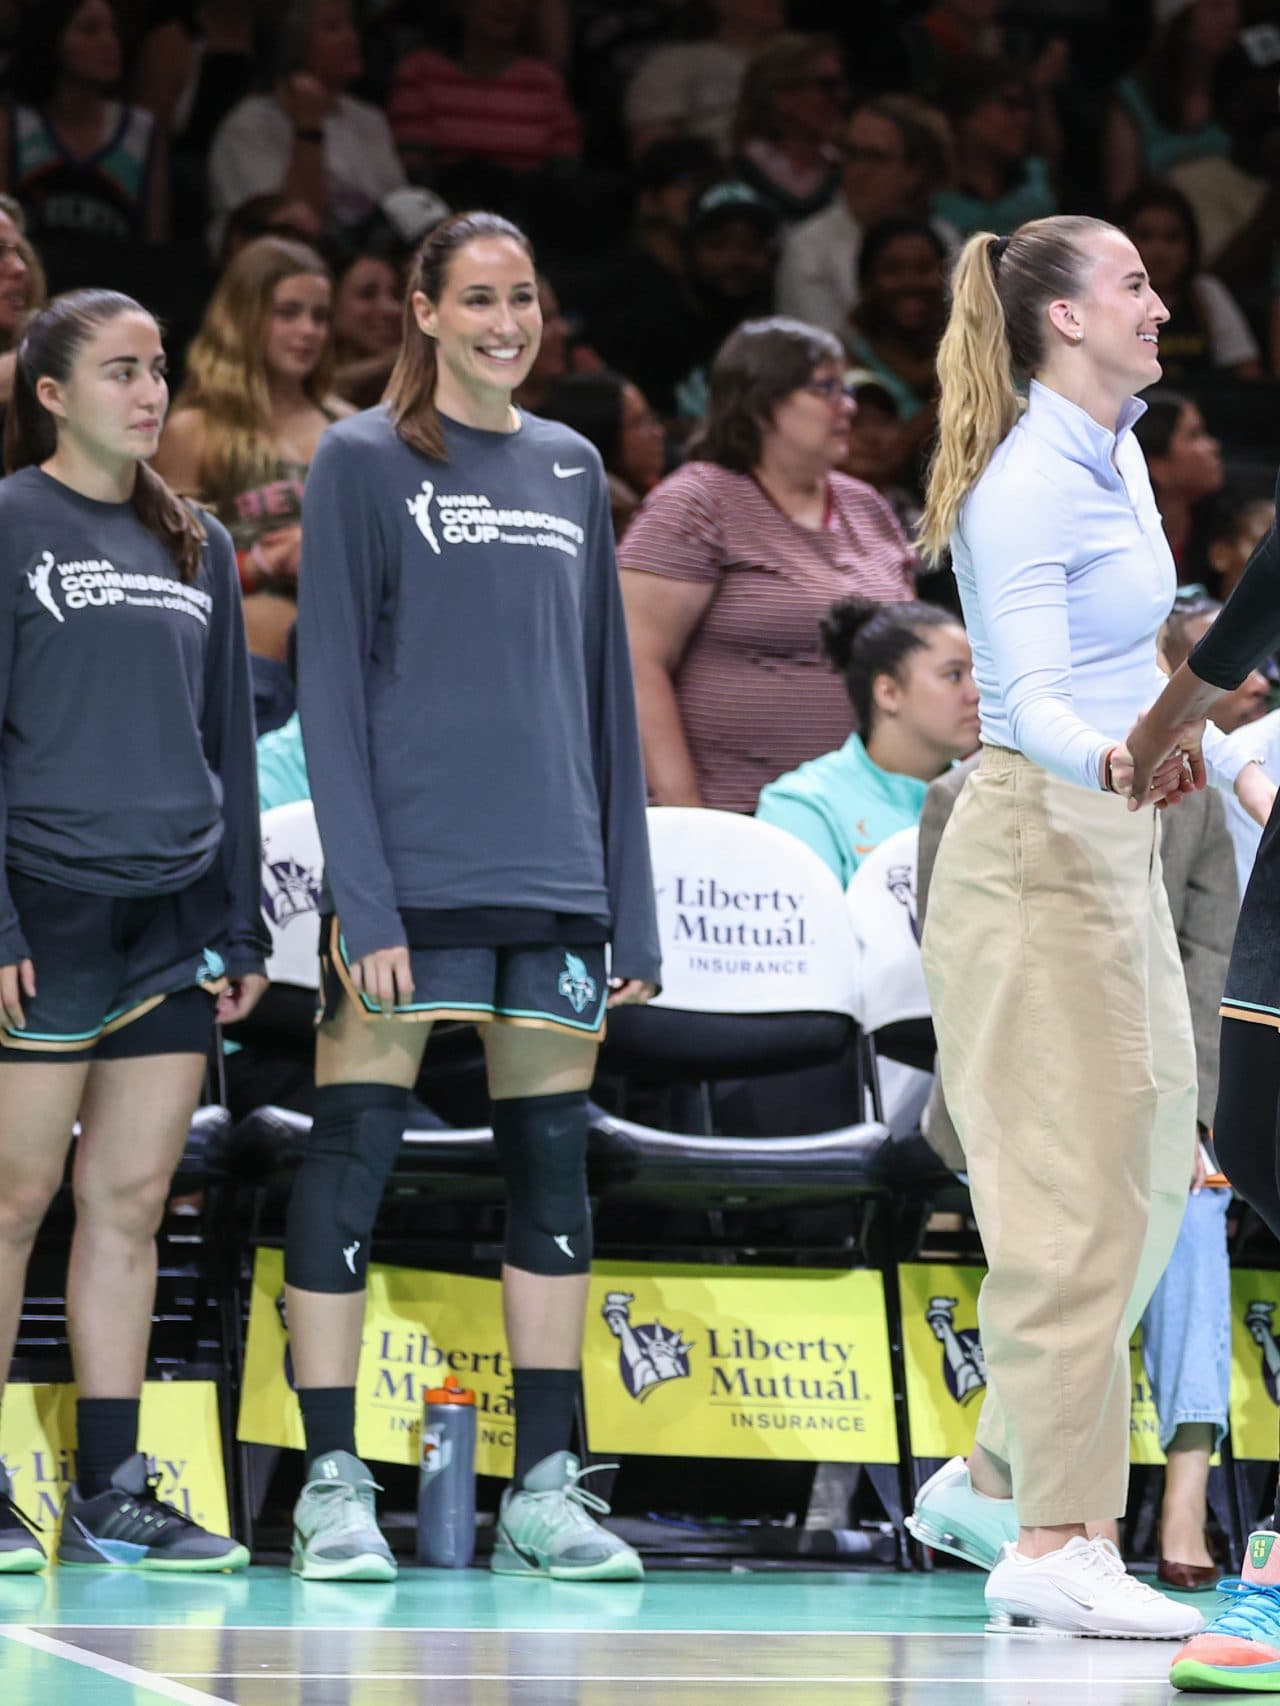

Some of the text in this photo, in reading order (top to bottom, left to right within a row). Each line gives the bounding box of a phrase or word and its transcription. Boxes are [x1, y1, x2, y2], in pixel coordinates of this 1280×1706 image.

[436, 495, 491, 508] WNBA
[443, 525, 500, 543] CUP
[57, 559, 115, 576] WNBA
[65, 587, 125, 608] CUP
[676, 877, 804, 922] Liberty
[688, 956, 809, 975] INSURANCE
[379, 1330, 513, 1378] Libert
[706, 1327, 855, 1375] Liberty
[389, 1415, 513, 1448] INSNC
[730, 1411, 866, 1433] INSURANCE
[32, 1450, 186, 1493] Lity
